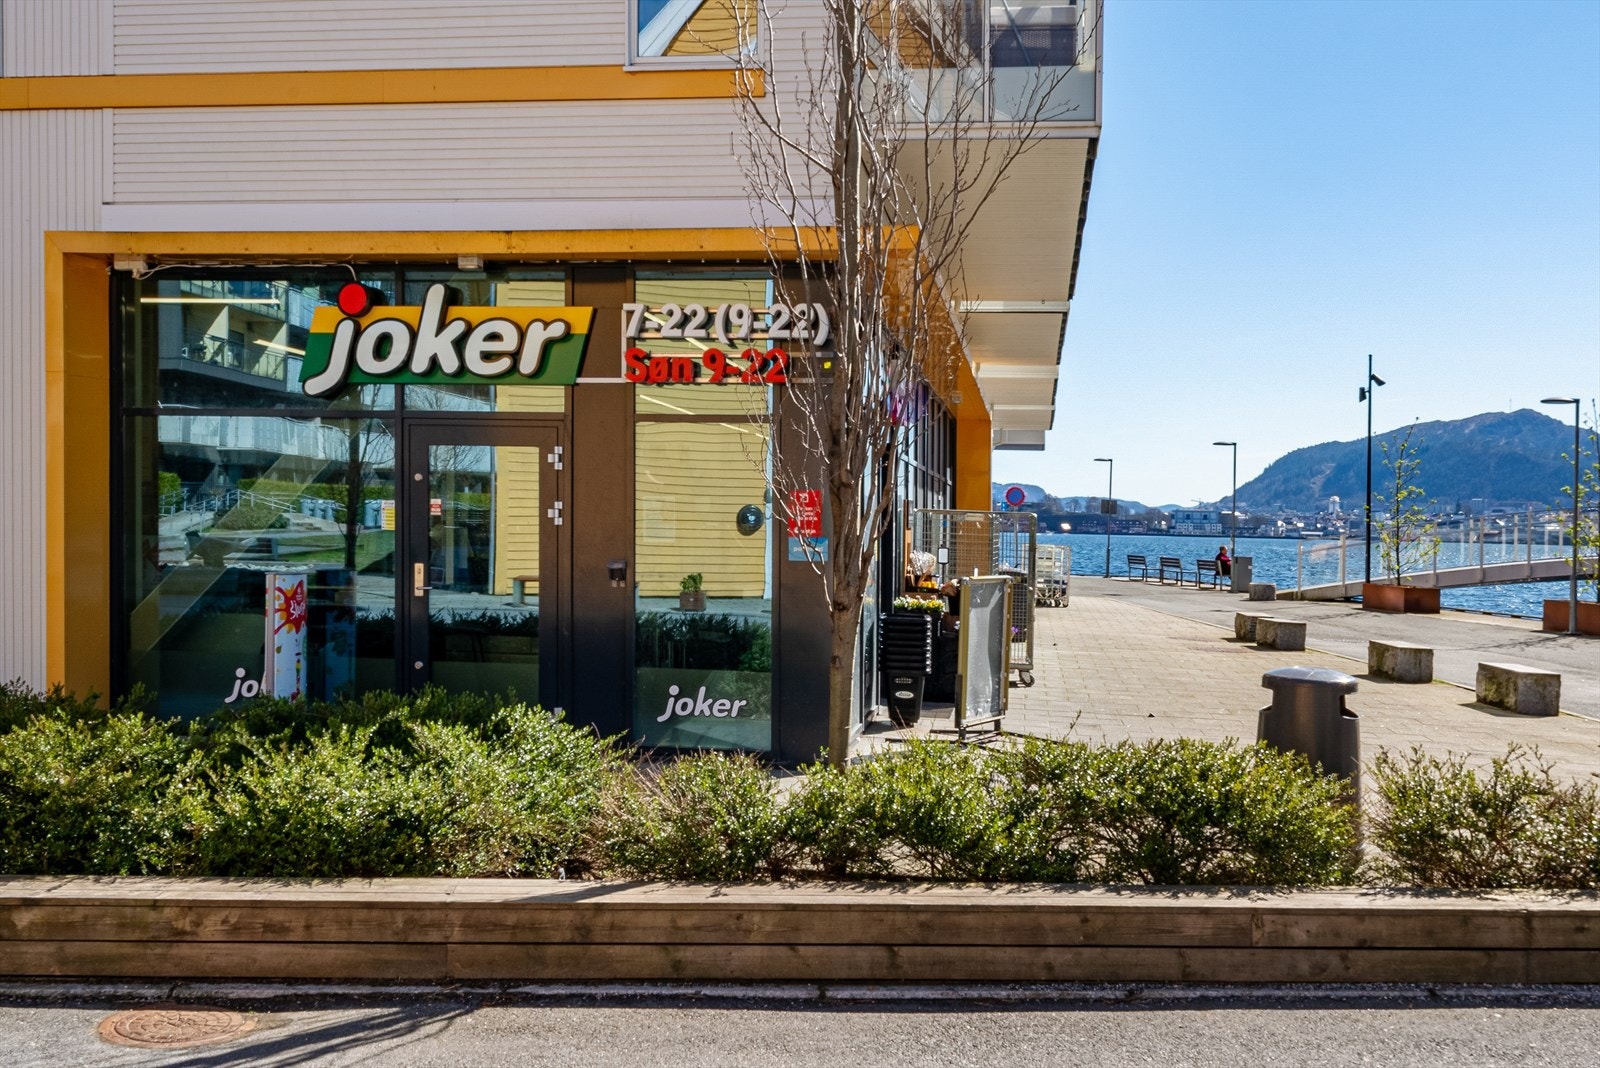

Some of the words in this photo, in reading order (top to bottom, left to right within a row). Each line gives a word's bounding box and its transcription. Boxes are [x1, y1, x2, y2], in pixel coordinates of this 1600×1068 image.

[302, 282, 571, 398] joker
[622, 302, 709, 338] 7-22
[714, 302, 831, 347] (9-22)
[624, 347, 694, 385] Søn
[701, 347, 790, 384] 9-22
[656, 684, 747, 723] joker
